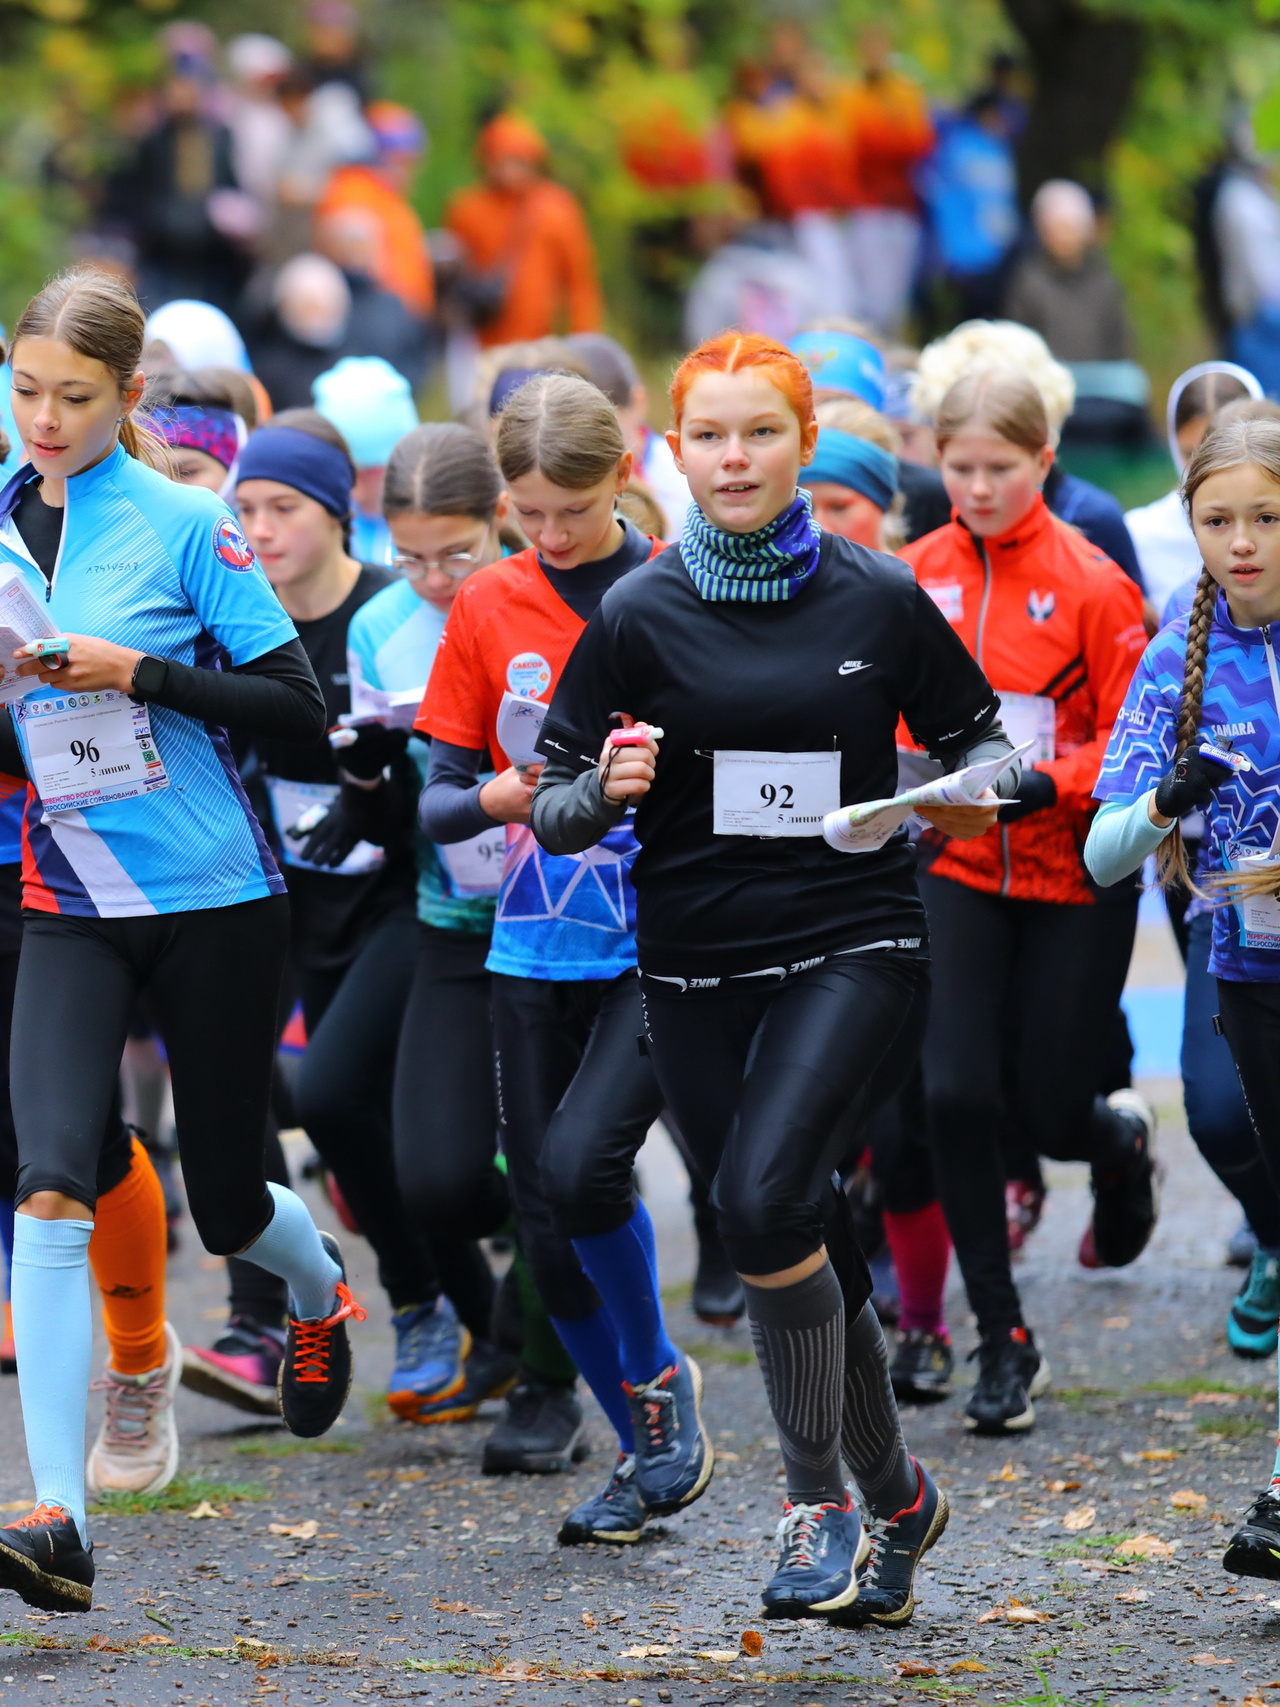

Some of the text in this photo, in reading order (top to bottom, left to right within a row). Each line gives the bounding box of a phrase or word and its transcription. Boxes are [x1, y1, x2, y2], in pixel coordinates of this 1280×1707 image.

[843, 660, 863, 668] NIKE
[134, 726, 150, 736] evo
[1211, 721, 1256, 737] SAMARA
[70, 736, 101, 767] 96
[91, 762, 131, 778] 5 линия
[43, 789, 102, 805] ЕРВЕНСТВО РОССИИ
[44, 789, 139, 813] СЕРОССИЙСКИЕ СОРЕВНОВАНИЯ
[760, 783, 795, 809] 92
[777, 813, 784, 824] 5
[897, 937, 922, 949] NIKE
[788, 955, 826, 975] NIKE
[688, 977, 721, 988] NIKE
